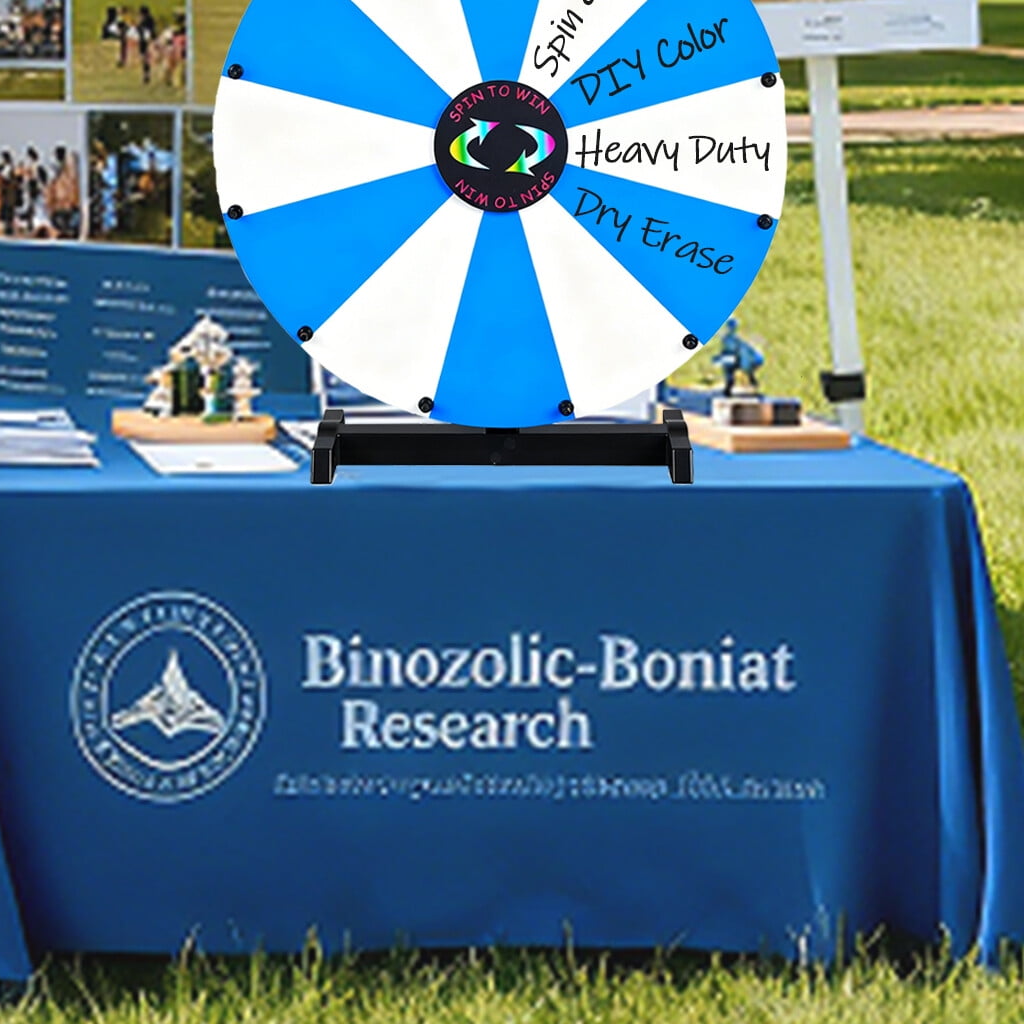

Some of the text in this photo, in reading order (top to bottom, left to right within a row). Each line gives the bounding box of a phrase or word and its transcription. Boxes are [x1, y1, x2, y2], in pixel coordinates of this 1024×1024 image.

[533, 7, 584, 78] Spin
[571, 17, 729, 106] DIY Color
[449, 85, 551, 123] SPIN TO WIN
[575, 129, 772, 172] Heavy Duty
[455, 171, 555, 209] SPIN TO WIN
[573, 187, 735, 275] Dry Erase
[301, 631, 797, 692] Binozolic-Boniat
[340, 699, 593, 751] Research
